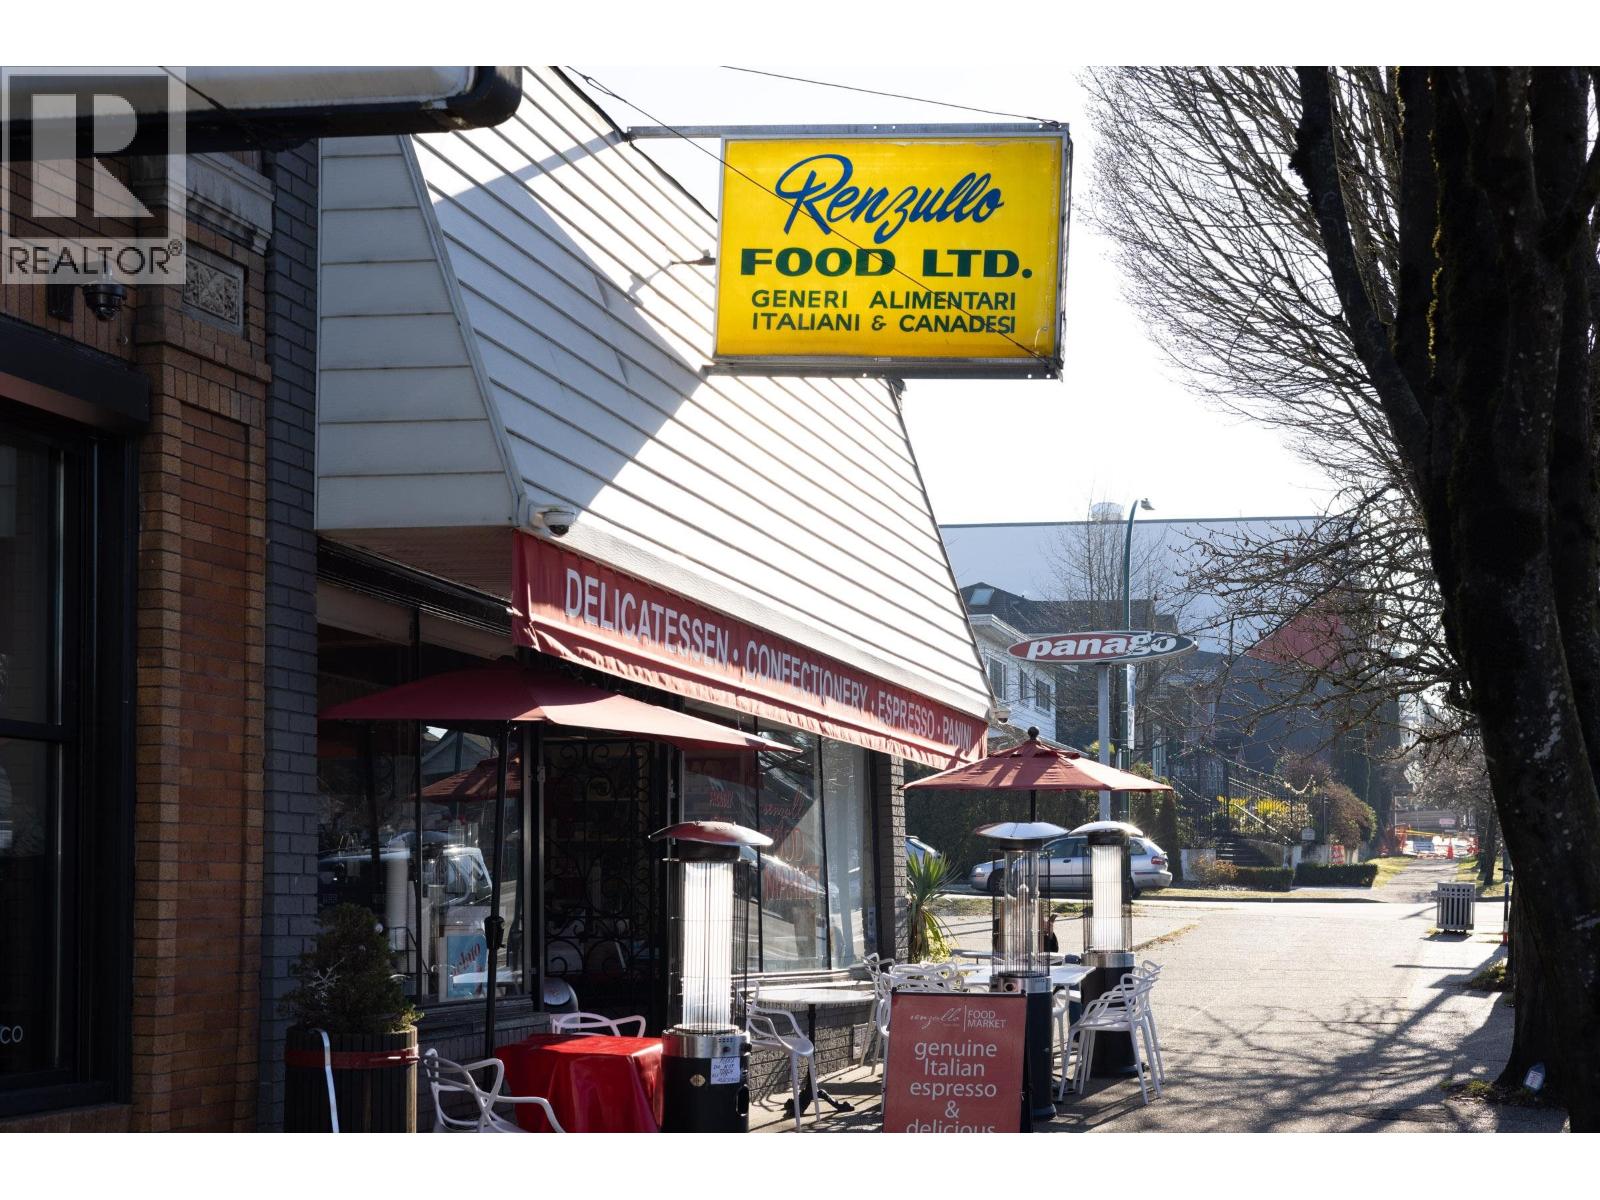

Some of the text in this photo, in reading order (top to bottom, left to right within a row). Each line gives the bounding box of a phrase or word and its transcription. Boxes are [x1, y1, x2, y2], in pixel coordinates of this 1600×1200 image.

[775, 153, 1004, 244] Renzullo
[740, 247, 1033, 279] FOOD LTD.
[751, 290, 1015, 311] GENERI ALIMENTARI
[752, 312, 1015, 334] ITALIANI & CANADESI
[1026, 631, 1177, 660] panago
[565, 568, 972, 753] DELICATESSEN CONFECTIONERY ESPRESSO PANINI
[967, 1010, 996, 1019] FOOD
[967, 1019, 1006, 1029] MARKET
[914, 1039, 998, 1061] genuine
[924, 1058, 985, 1077] Italian
[910, 1081, 997, 1100] espresso
[944, 1100, 960, 1119] &
